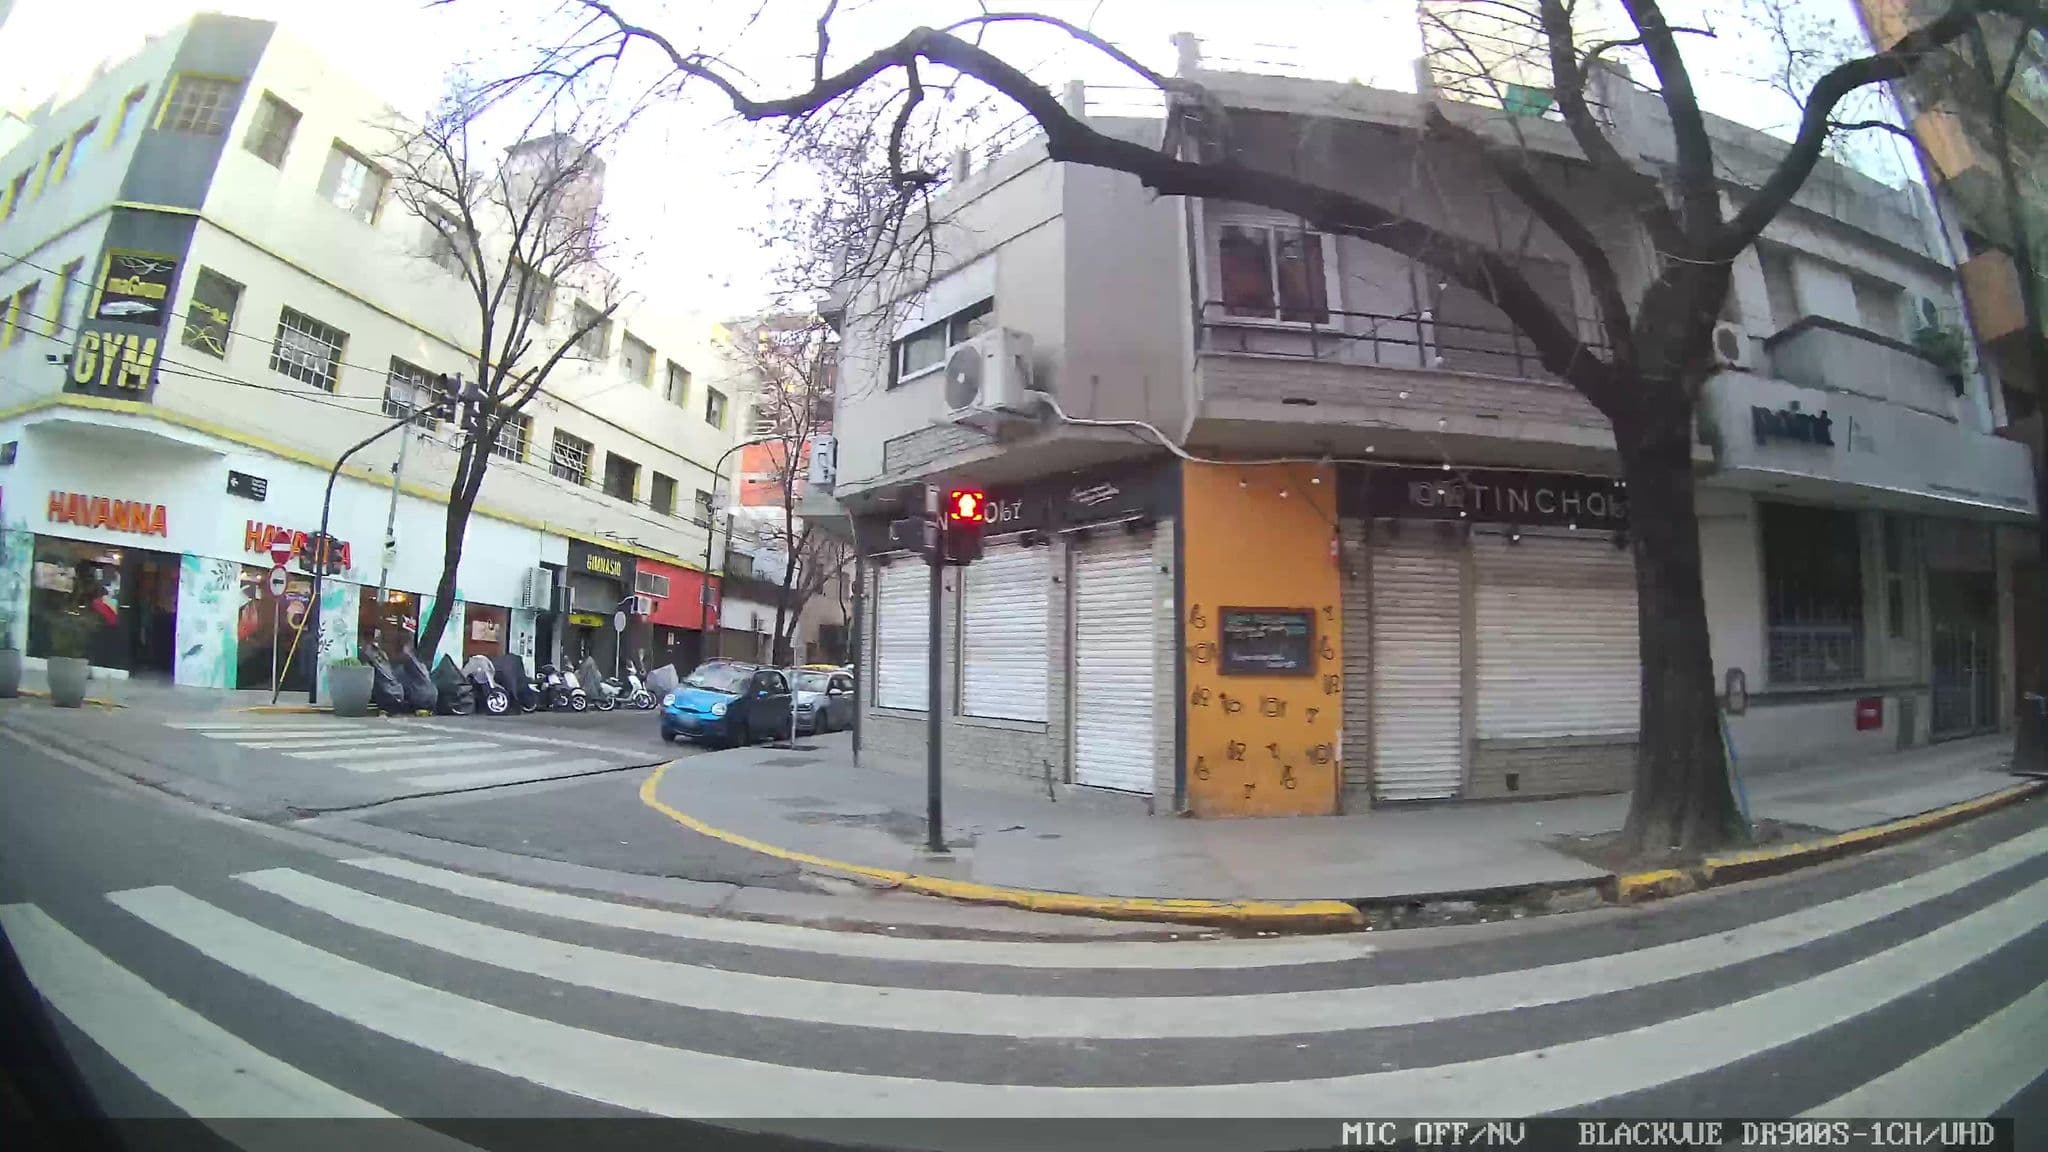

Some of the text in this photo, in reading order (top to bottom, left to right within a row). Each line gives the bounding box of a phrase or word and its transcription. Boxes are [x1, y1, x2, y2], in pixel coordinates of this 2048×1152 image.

[74, 329, 158, 389] GYM
[48, 490, 167, 538] HAVANNA
[245, 519, 352, 570] HAAA
[587, 554, 621, 576] GIMNASIO
